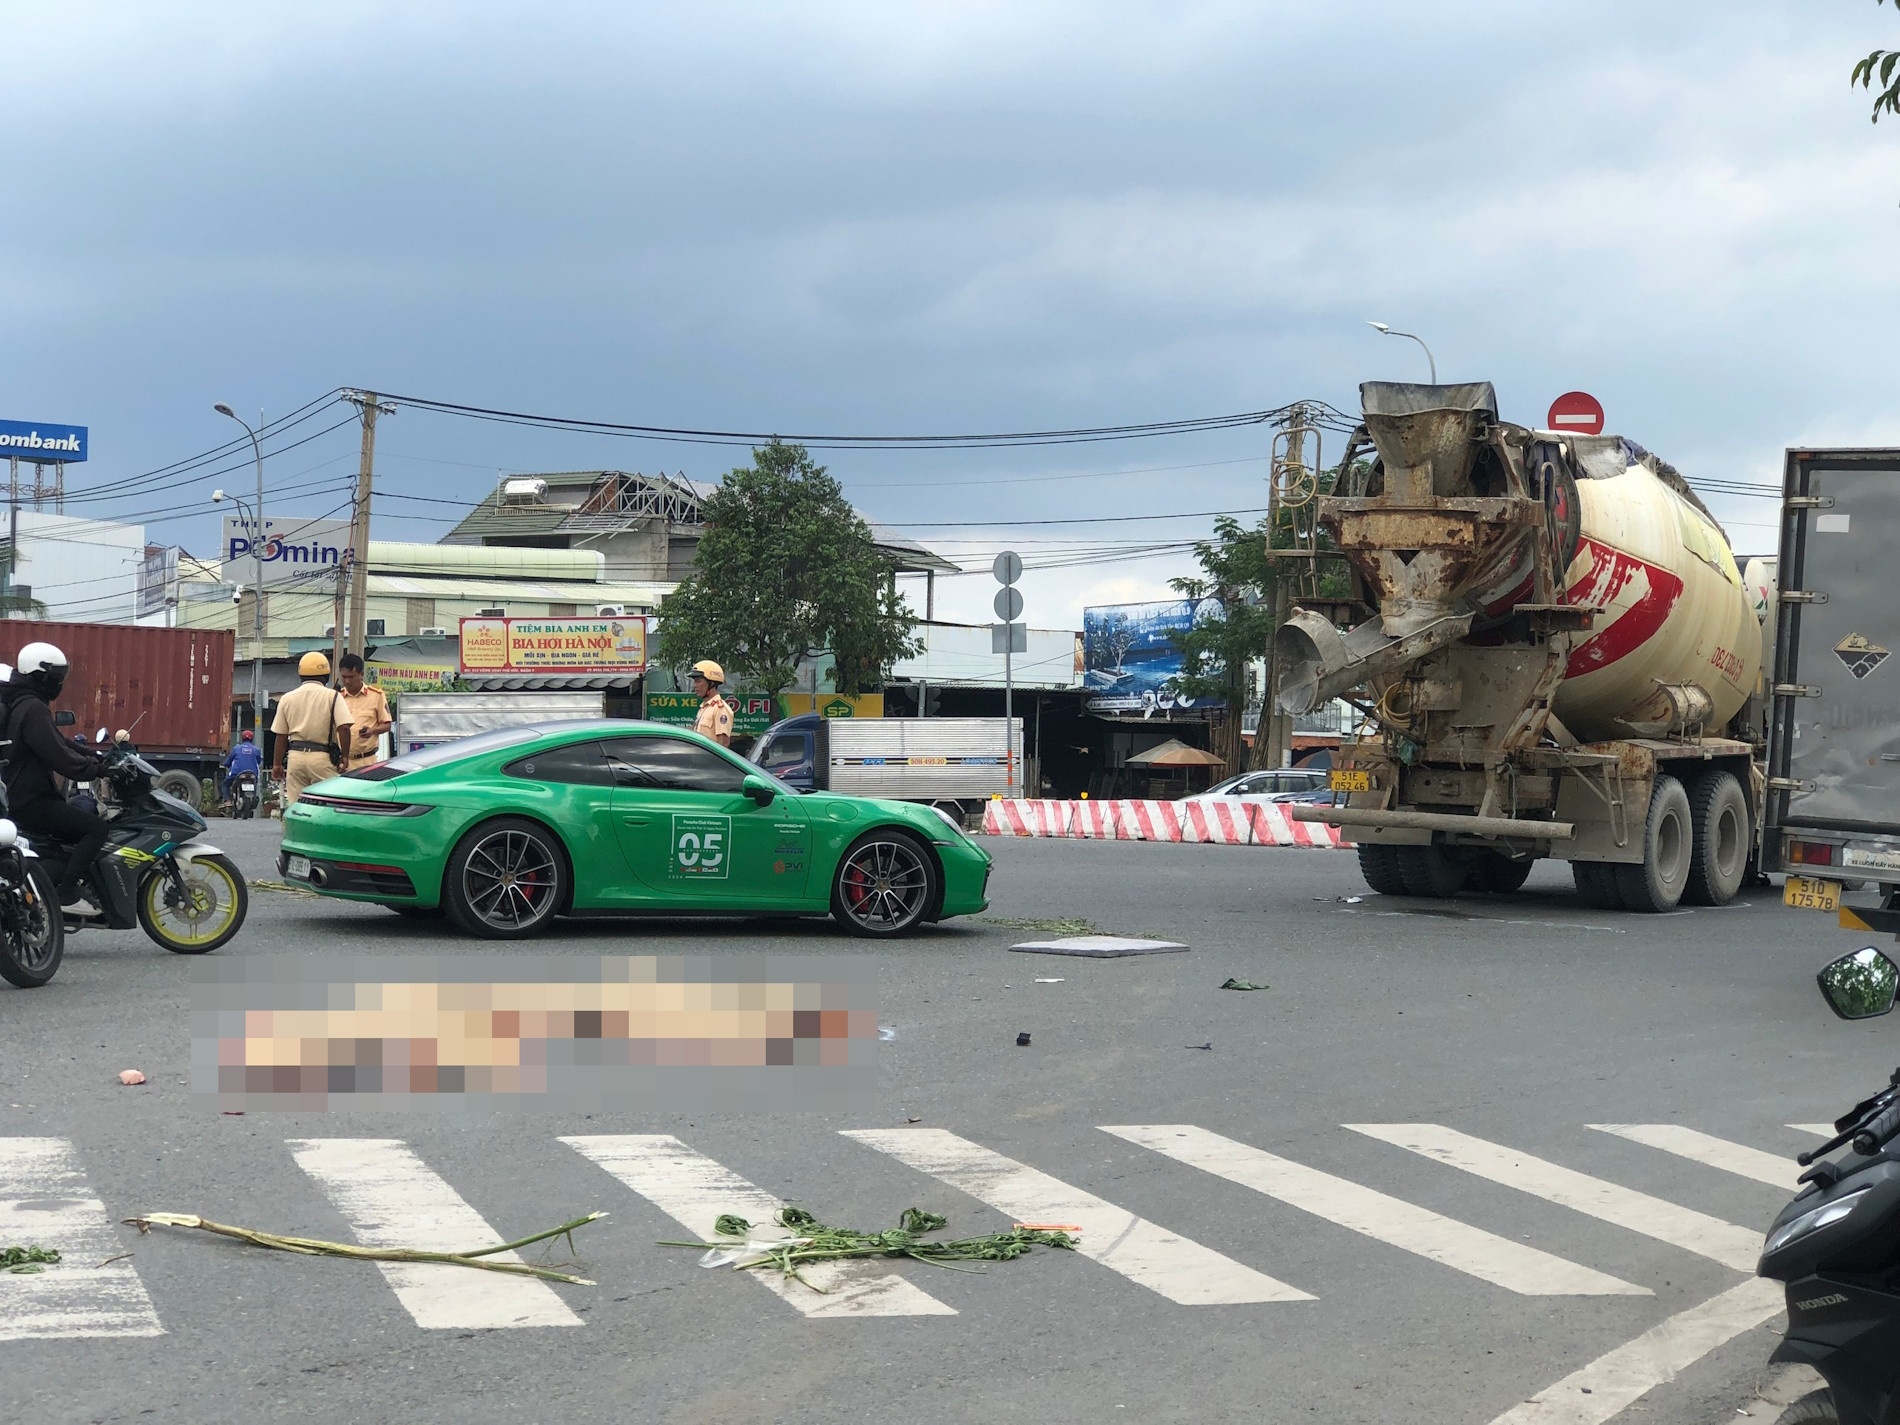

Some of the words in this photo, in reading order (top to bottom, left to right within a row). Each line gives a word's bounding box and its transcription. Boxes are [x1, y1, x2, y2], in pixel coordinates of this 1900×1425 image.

[516, 623, 541, 634] TIỆM
[545, 625, 563, 633] BIA
[567, 625, 589, 633] ANH
[467, 638, 502, 646] HABECO
[512, 638, 534, 649] BIA
[537, 637, 562, 649] HƠI
[565, 635, 585, 649] HÀ
[587, 635, 612, 651] NỘI
[414, 670, 428, 679] ANH
[429, 671, 439, 679] EM
[650, 695, 678, 707] SỬA
[681, 698, 698, 707] XE
[827, 706, 849, 717] SP
[1341, 772, 1358, 781] 51E
[1335, 782, 1365, 791] 052.46
[678, 832, 723, 867] 05
[1801, 880, 1825, 894] 51D
[1791, 893, 1833, 910] 175.78
[1795, 1293, 1849, 1310] HONDA
